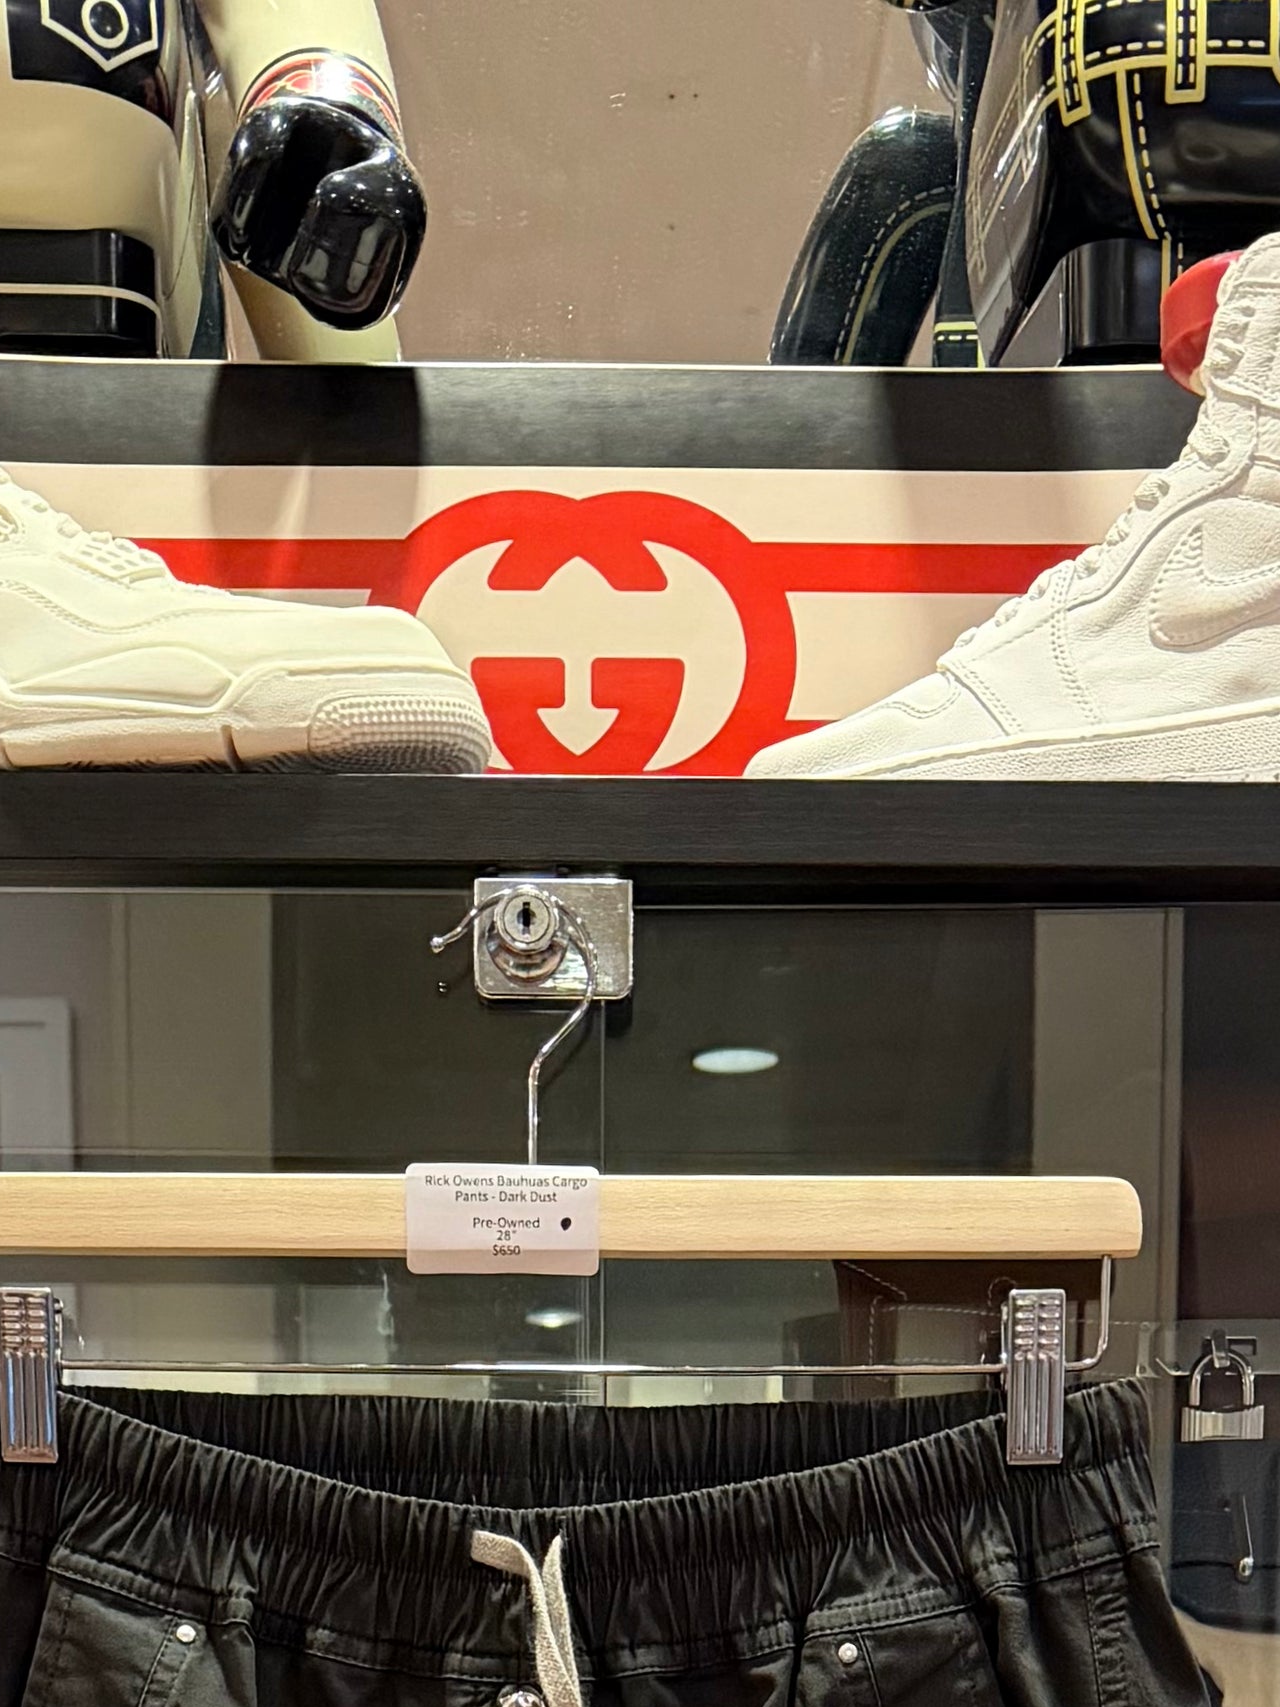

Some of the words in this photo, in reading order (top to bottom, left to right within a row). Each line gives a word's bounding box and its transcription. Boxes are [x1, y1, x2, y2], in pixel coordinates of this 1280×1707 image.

[425, 1175, 450, 1187] Rick
[453, 1175, 494, 1187] Owens
[497, 1175, 550, 1187] Bauhuas
[552, 1175, 588, 1190] Cargo
[455, 1190, 489, 1202] Pants
[499, 1190, 527, 1203] Dark
[530, 1191, 558, 1203] Dust
[473, 1217, 541, 1229] Pre-Owned
[492, 1244, 521, 1256] $650
